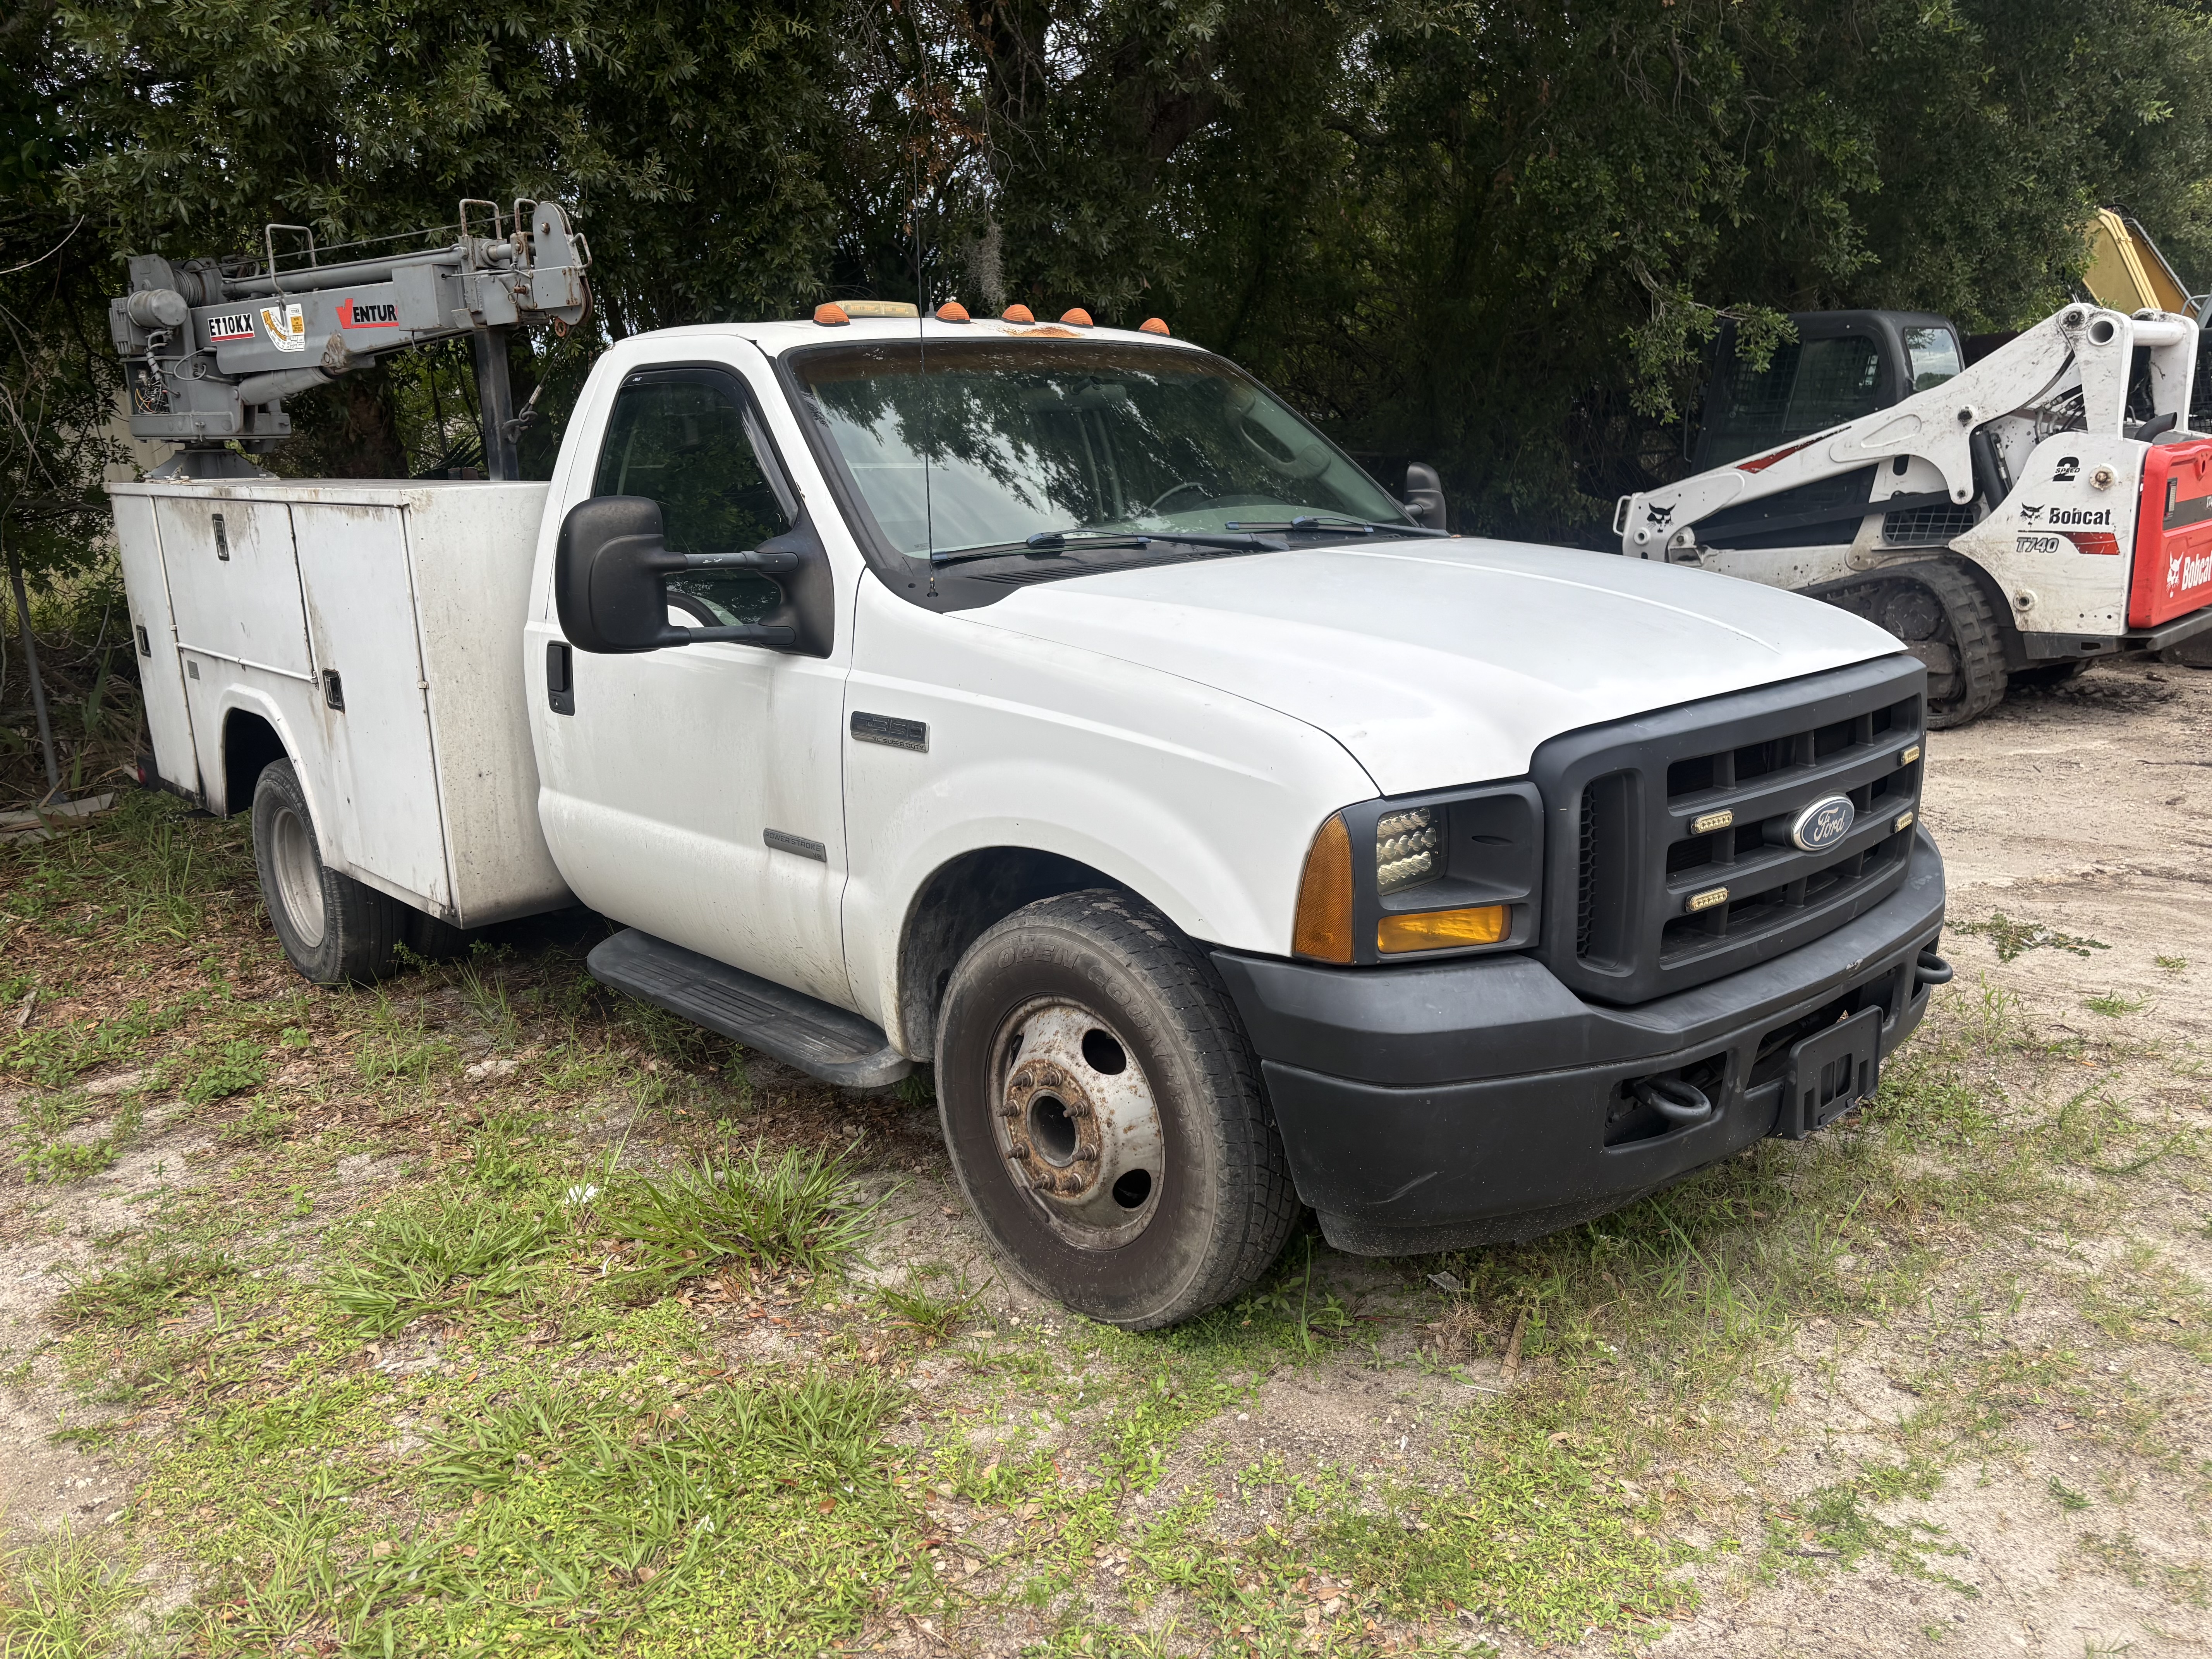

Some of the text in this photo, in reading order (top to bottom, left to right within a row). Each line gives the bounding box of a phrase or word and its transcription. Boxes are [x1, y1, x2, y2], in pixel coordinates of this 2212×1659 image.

[208, 314, 253, 336] ET10KX
[2053, 457, 2079, 481] 2
[2049, 507, 2111, 525] Bobcat
[2016, 536, 2059, 553] T740
[883, 739, 905, 747] SUPER
[1814, 807, 1846, 842] Ford
[765, 831, 821, 852] POWER STROKE
[998, 943, 1079, 969] OPEN
